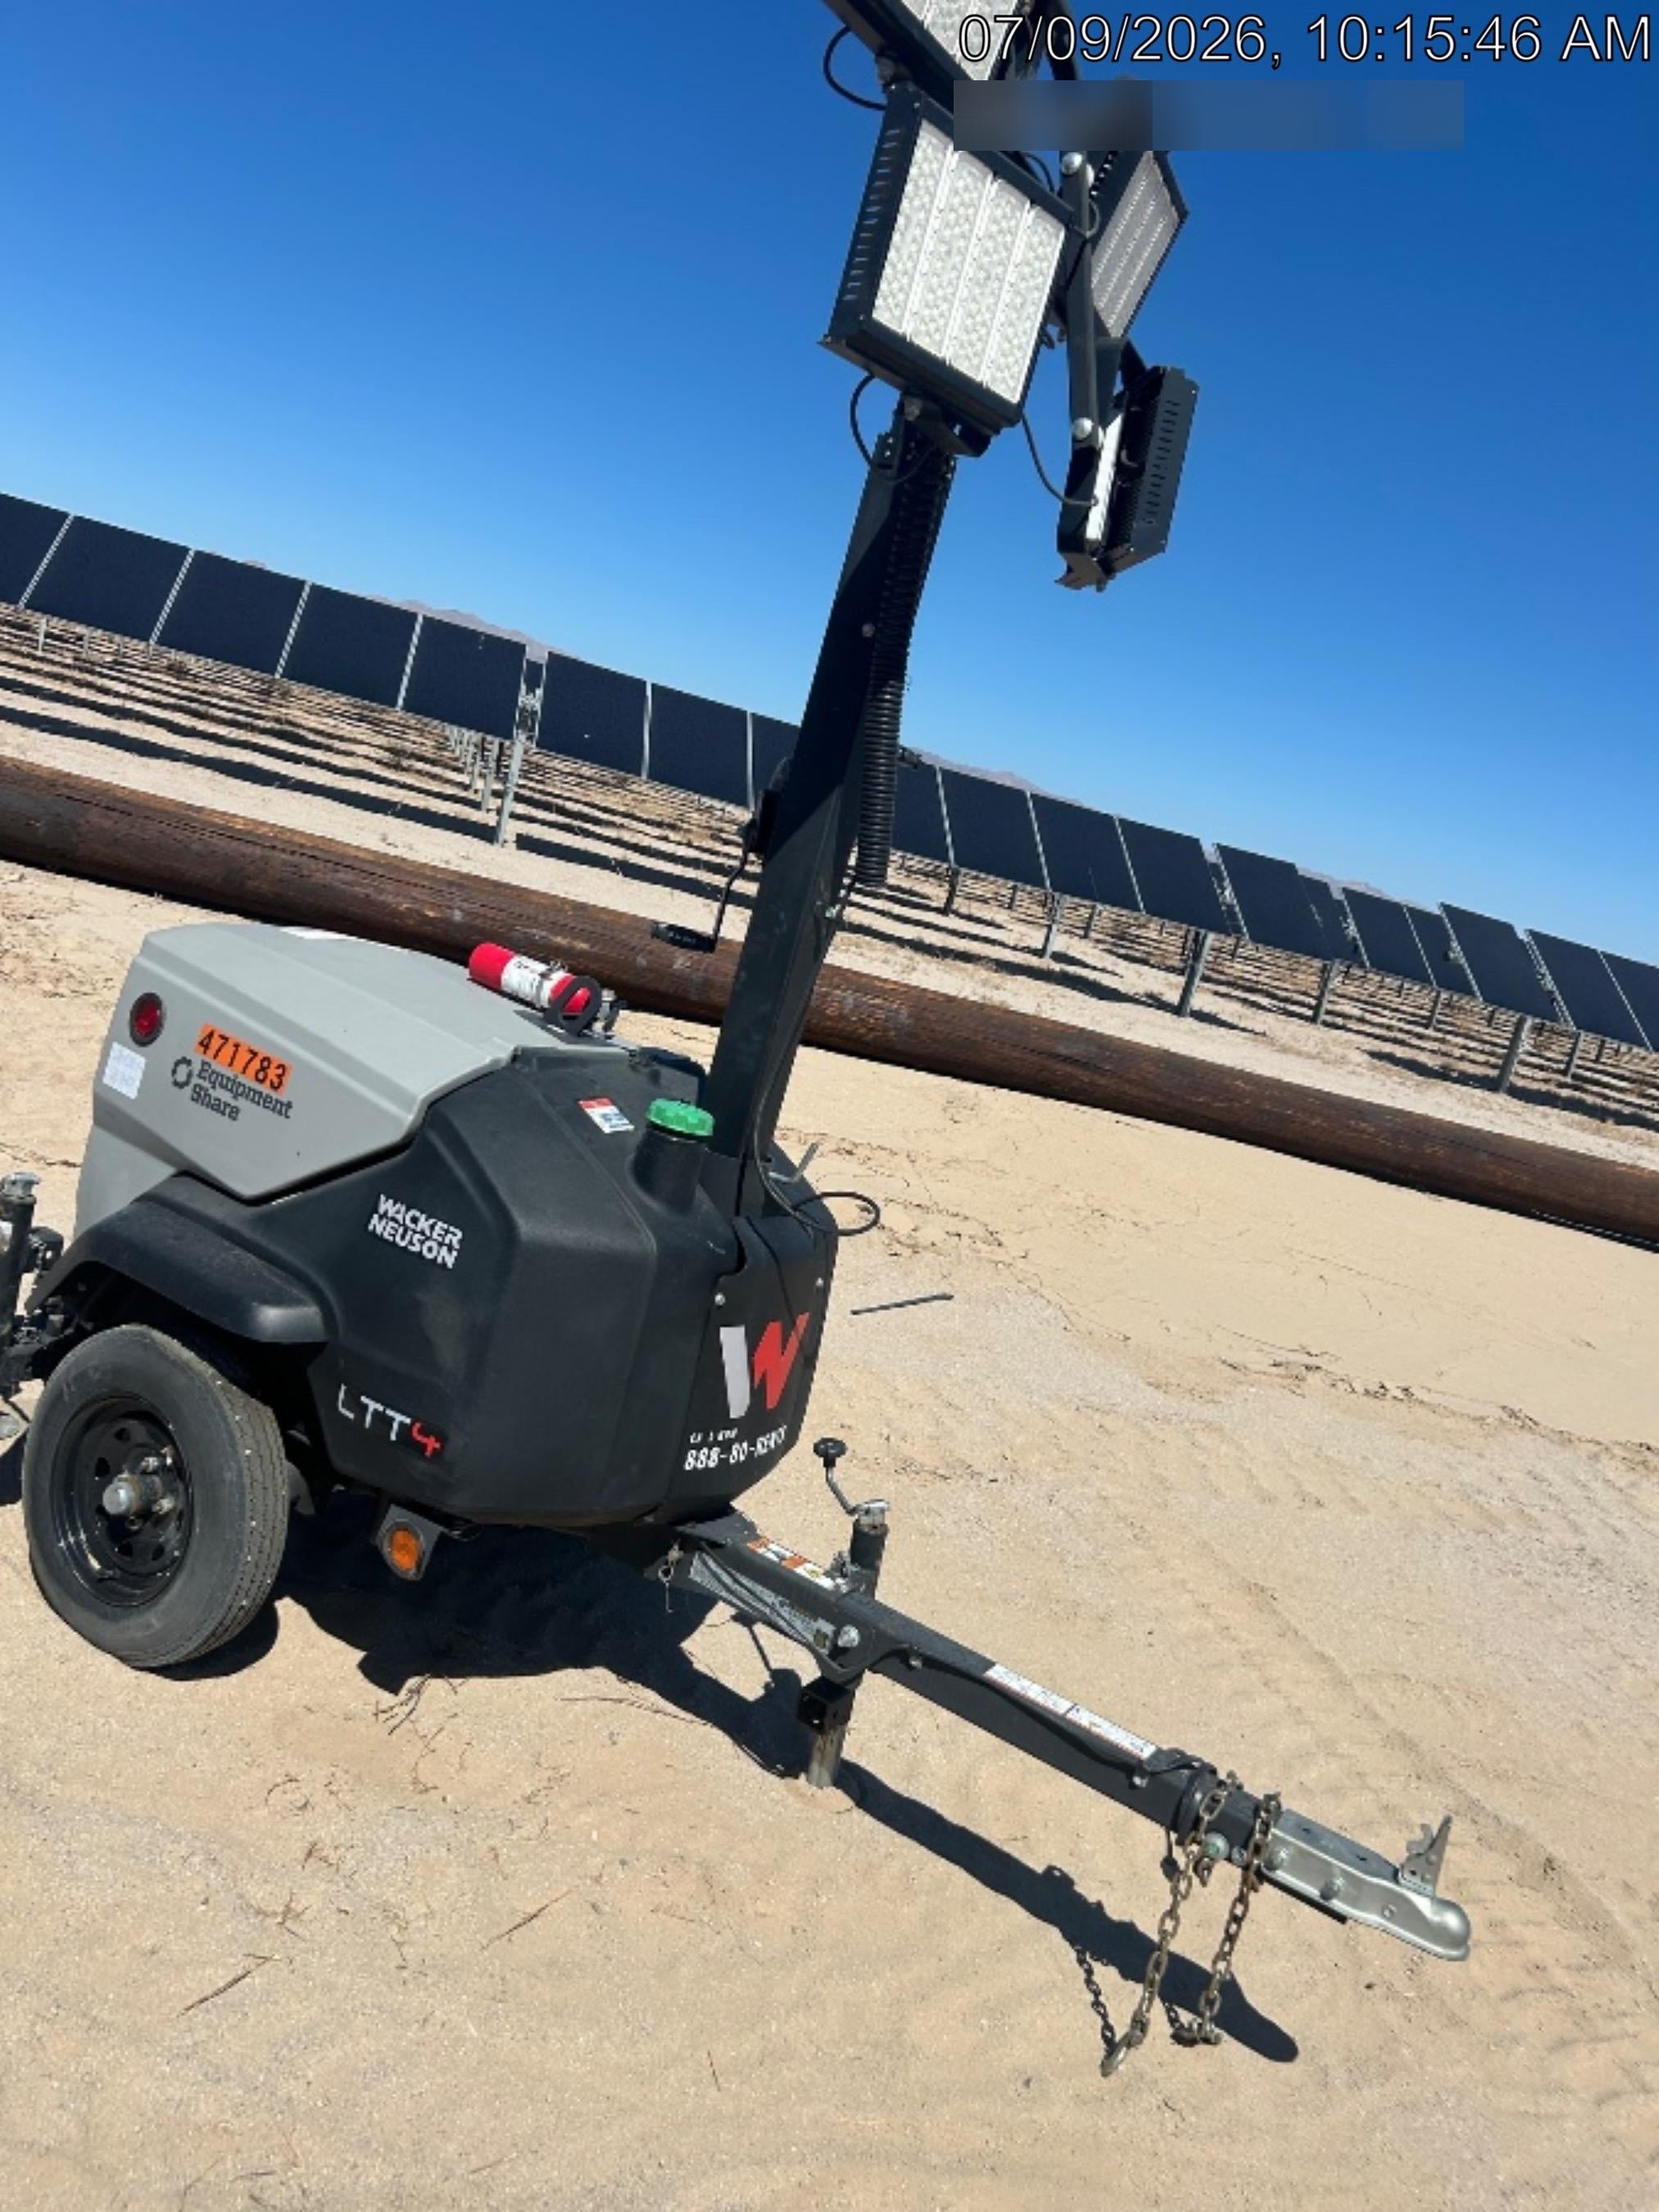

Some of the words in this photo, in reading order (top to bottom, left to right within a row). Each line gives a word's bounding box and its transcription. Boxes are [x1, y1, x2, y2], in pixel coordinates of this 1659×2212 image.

[196, 1059, 293, 1119] Equipment
[197, 1029, 287, 1093] 471783
[190, 1082, 242, 1122] Share
[368, 1213, 458, 1269] NEUSON
[378, 1194, 463, 1250] WACKER
[337, 1383, 440, 1457] LTT4
